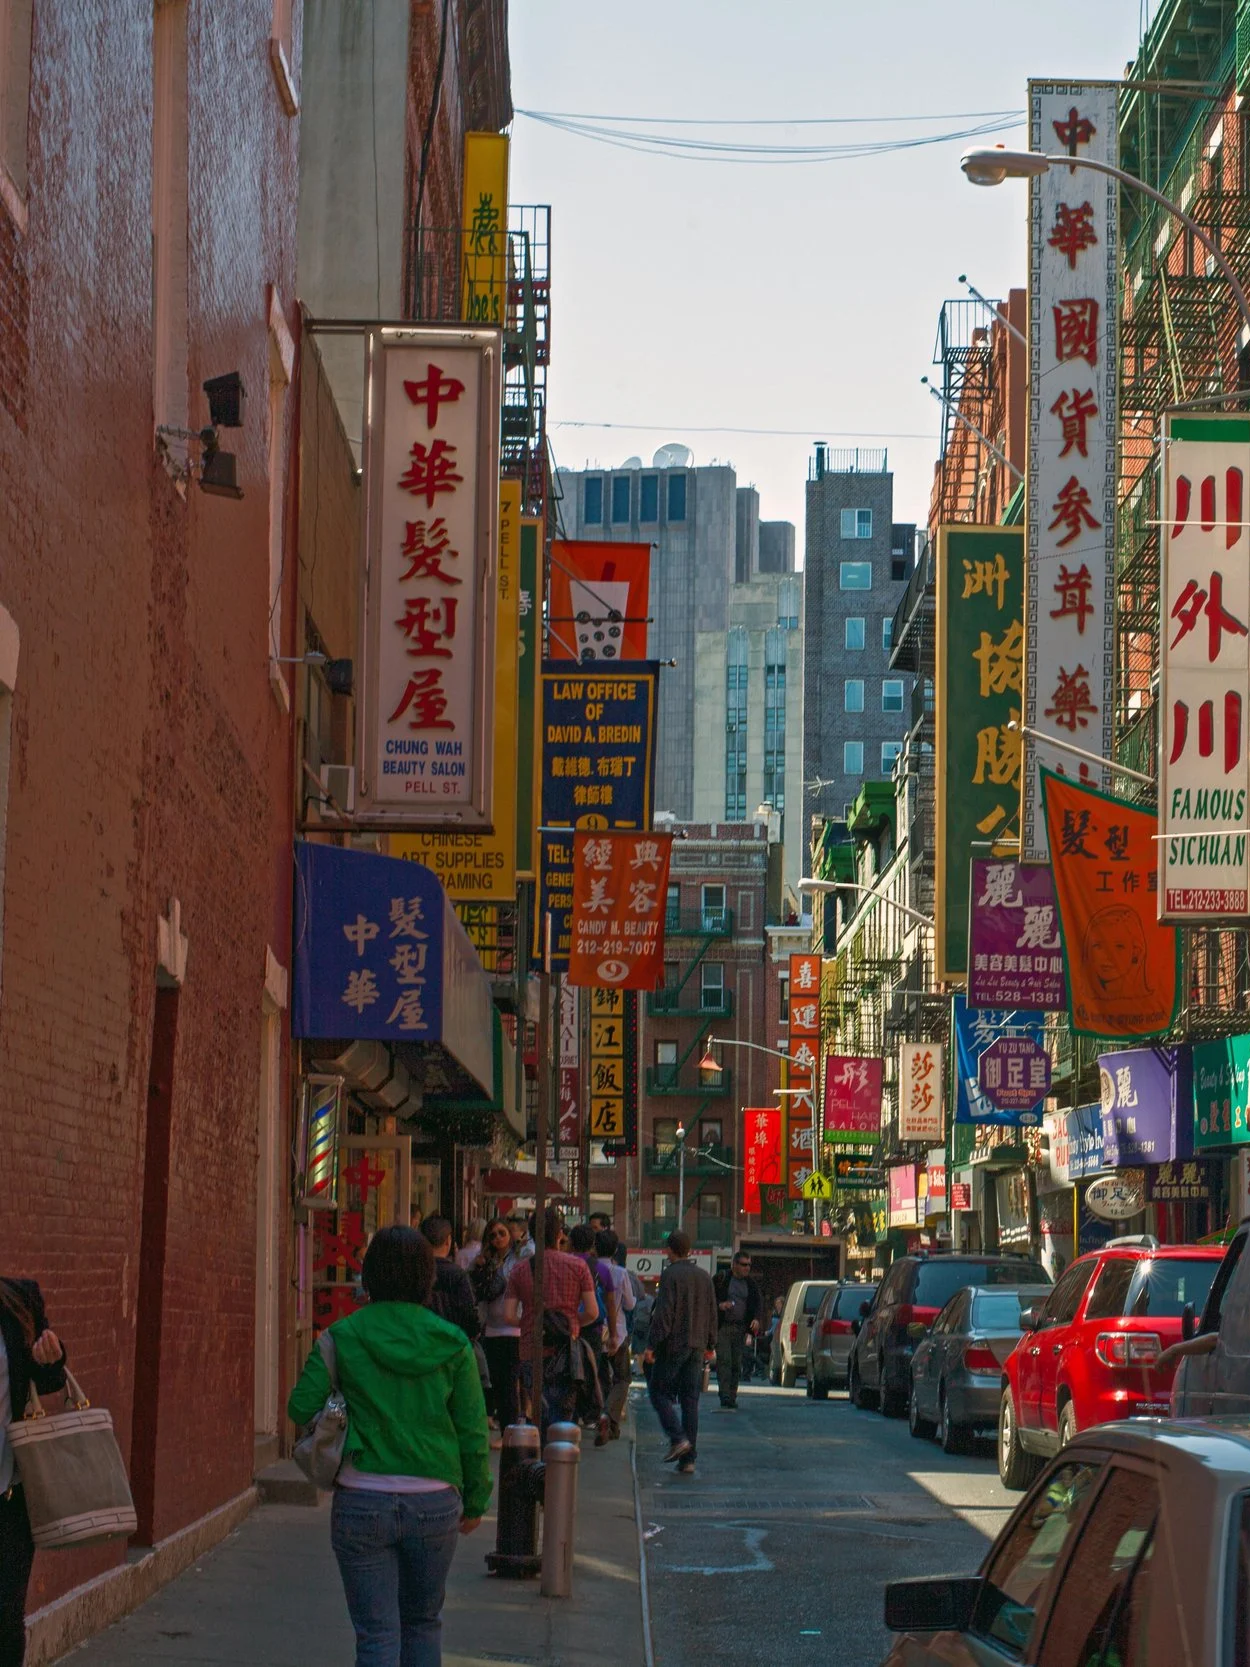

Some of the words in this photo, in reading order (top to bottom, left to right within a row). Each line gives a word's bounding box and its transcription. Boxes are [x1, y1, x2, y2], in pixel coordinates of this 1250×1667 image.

[1043, 106, 1102, 788] 中華國貨參茸藥
[501, 501, 511, 512] 7
[387, 363, 466, 732] 中華髮型屋
[1169, 466, 1249, 774] 川外川
[553, 682, 584, 700] LAW
[587, 682, 636, 700] OFFICE
[585, 703, 604, 720] OF
[547, 725, 581, 743] DAVID
[584, 726, 595, 743] A.
[598, 725, 641, 743] BREDIN
[386, 740, 428, 754] CHUNG
[435, 741, 462, 755] WAH
[383, 761, 425, 775] BEAUTY
[431, 761, 465, 776] SALON
[405, 781, 436, 793] PELL
[443, 782, 461, 794] ST.
[1171, 788, 1245, 821] FAMOUS
[421, 833, 482, 847] CHINESE
[1169, 835, 1246, 866] SICHUAN
[436, 852, 504, 868] SUPPLIES
[440, 873, 493, 889] RAMING
[1169, 890, 1245, 911] TEL:212-233-3888
[577, 920, 607, 935] CANDY
[624, 921, 658, 936] BEAUTY
[576, 939, 657, 956] 212-219-7007
[341, 914, 380, 1014] 中華
[386, 896, 430, 1030] 髮型屋
[1020, 1043, 1035, 1054] TANG
[593, 987, 622, 1132] 錦江飯店
[986, 1057, 1046, 1088] 御足堂
[831, 1098, 861, 1113] PELL
[829, 1121, 879, 1131] SALON
